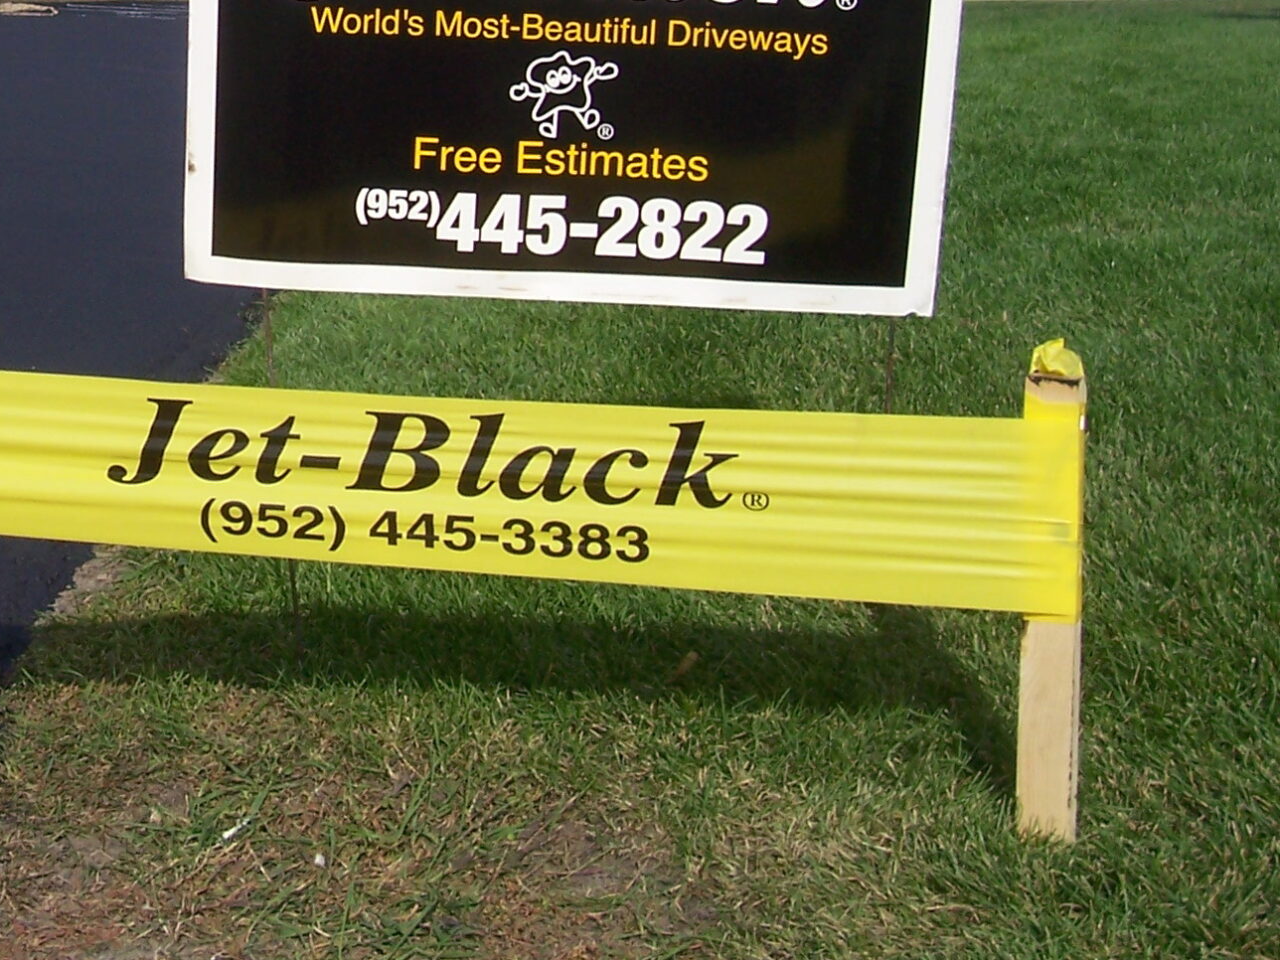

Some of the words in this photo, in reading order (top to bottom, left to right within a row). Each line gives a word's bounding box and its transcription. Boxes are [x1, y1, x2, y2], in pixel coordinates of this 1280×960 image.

[310, 6, 424, 38] World's
[434, 11, 657, 46] Most-Beautiful
[667, 19, 829, 58] Driveways
[413, 136, 502, 174] Free
[516, 140, 709, 183] Estimates
[200, 497, 346, 552] (952)
[369, 509, 651, 564] 445-3383
